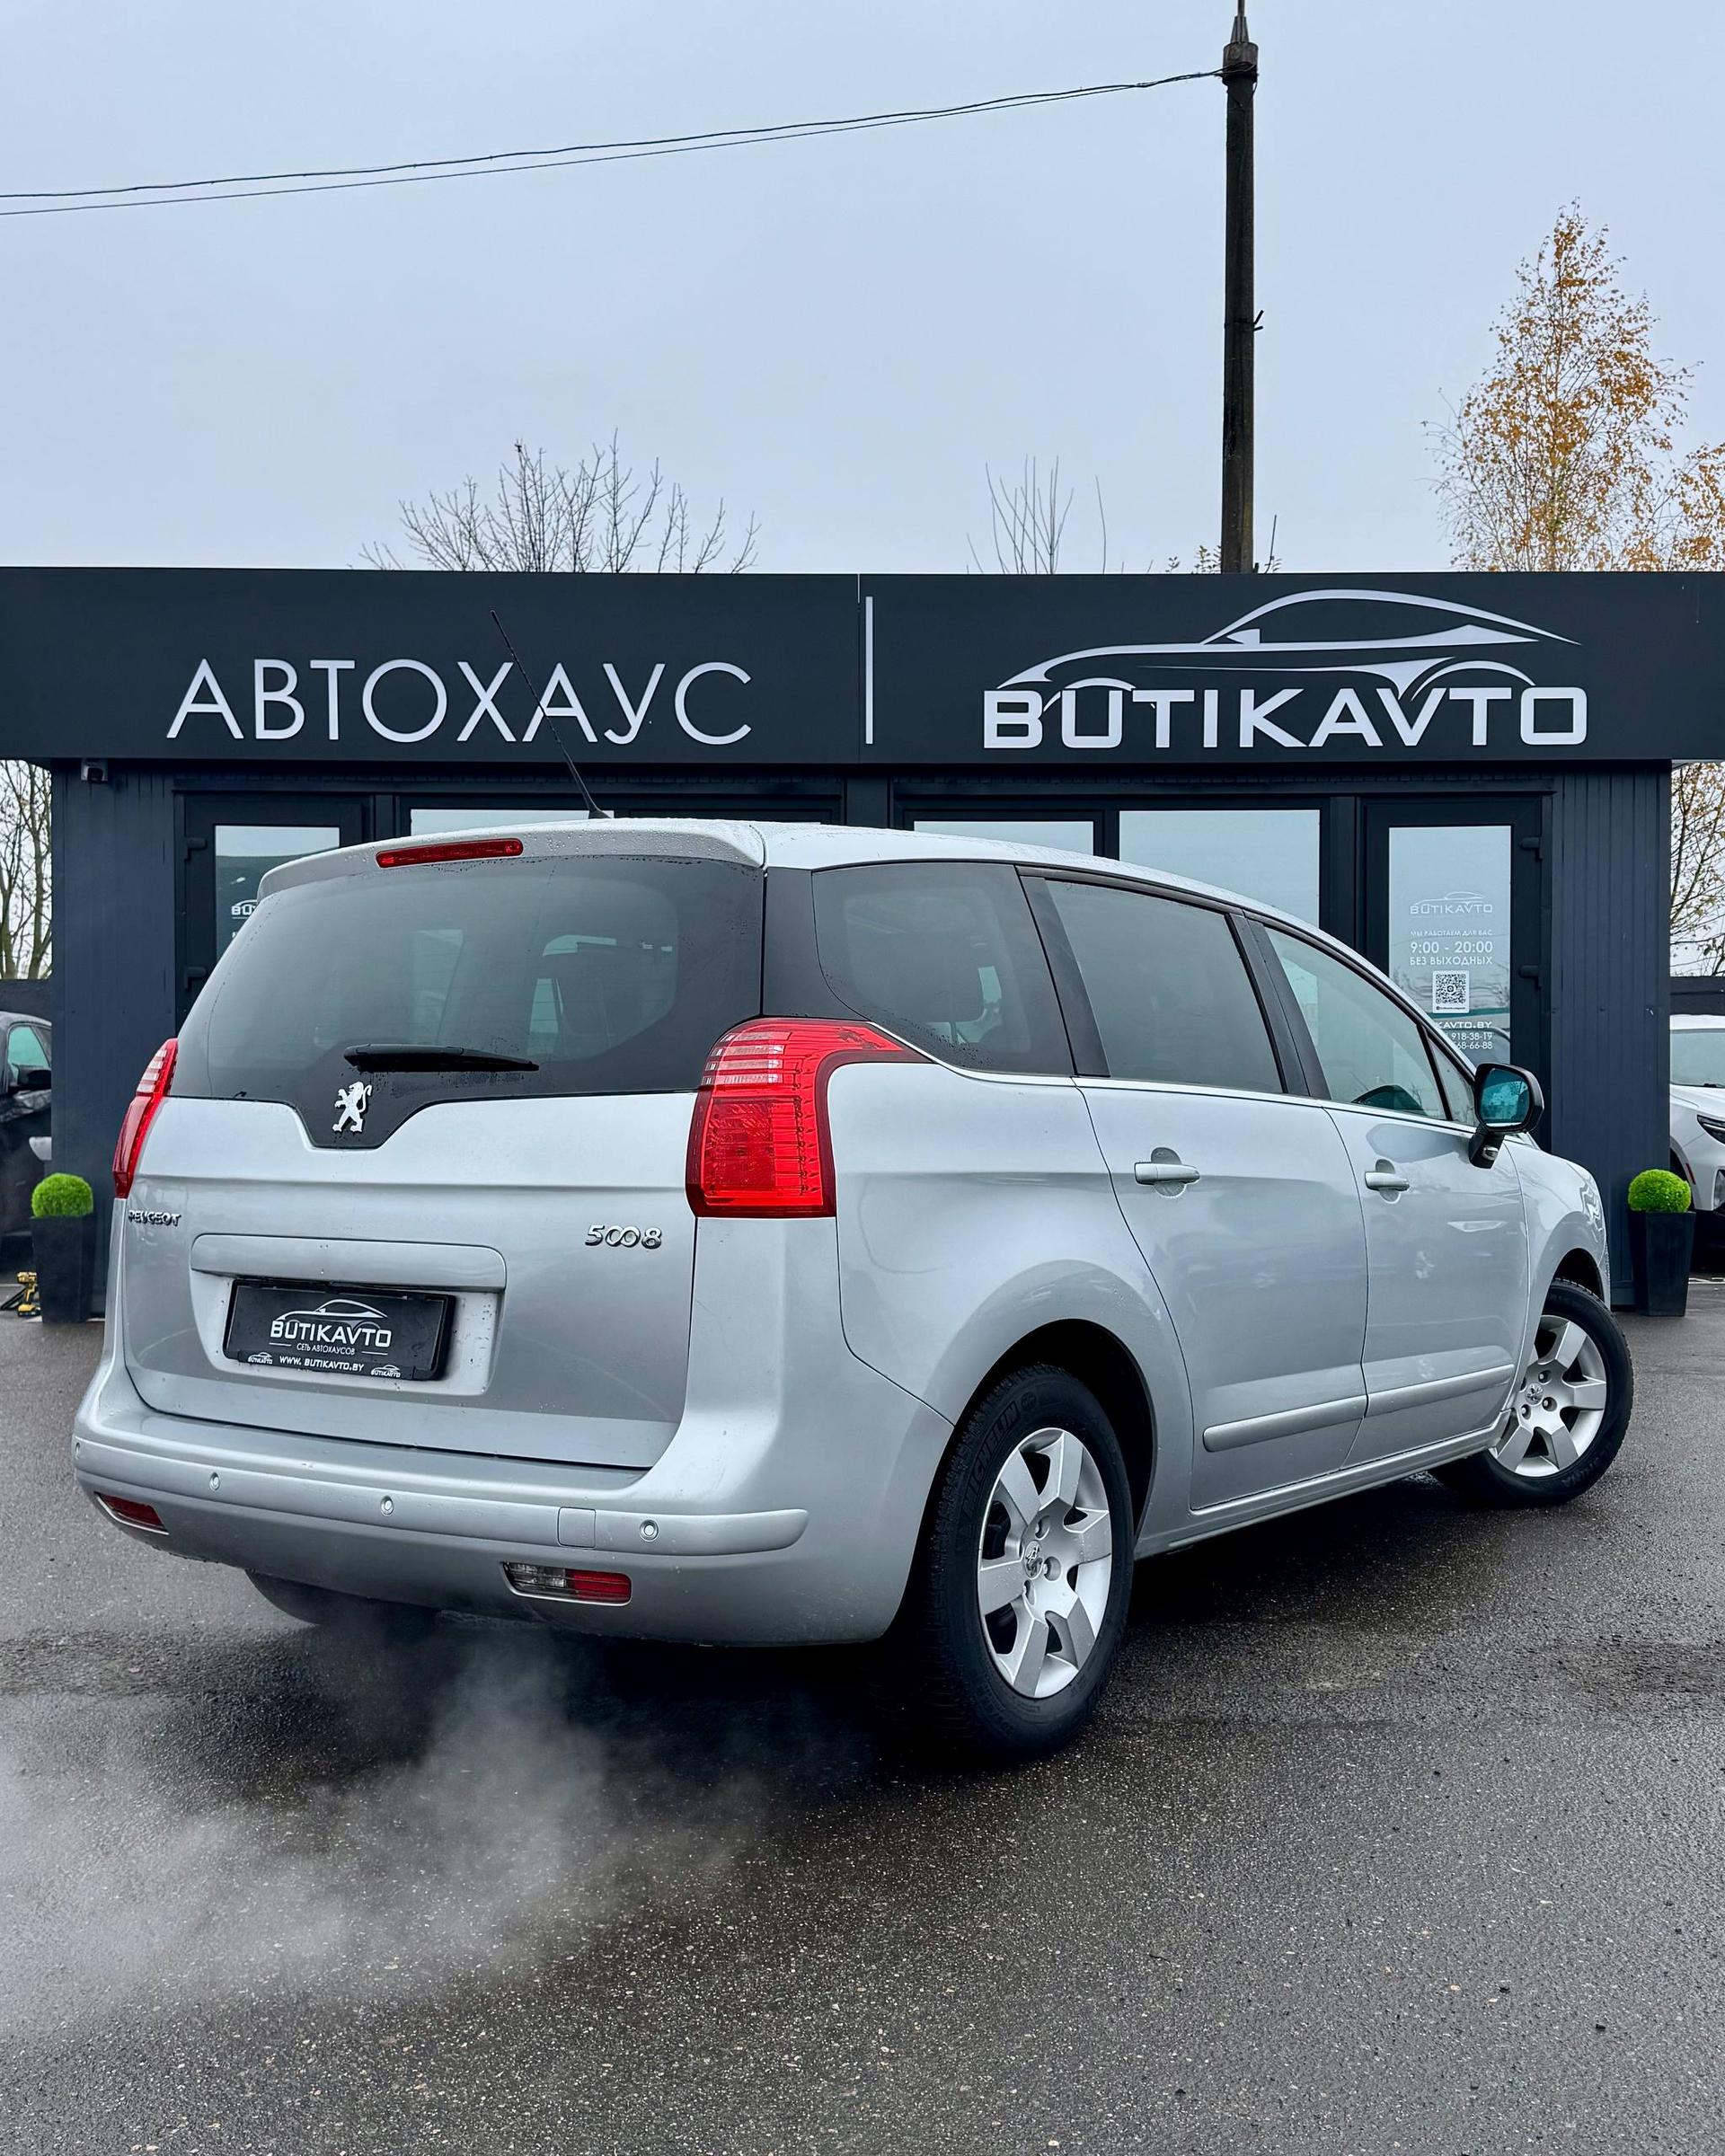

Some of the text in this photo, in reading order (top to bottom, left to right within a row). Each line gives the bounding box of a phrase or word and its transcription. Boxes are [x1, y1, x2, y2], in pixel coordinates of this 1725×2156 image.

[167, 658, 753, 746] АВТОХАУС
[983, 685, 1588, 749] BUTIKAVTO
[1410, 903, 1493, 915] BUTIKAVTO
[1410, 941, 1439, 954] 9:00
[1454, 941, 1493, 954] 20:00
[1410, 956, 1493, 967] БЕЗ ВЫХОДНЫХ
[1437, 1021, 1492, 1029] KAVTO.BY
[1455, 1041, 1493, 1049] 68-66-88
[128, 1209, 181, 1226] PEUGEOT
[584, 1224, 662, 1250] 5008
[270, 1320, 392, 1348] BUTIKAVTO
[296, 1342, 356, 1356] СЕТЬ АВТОХАУСОВ
